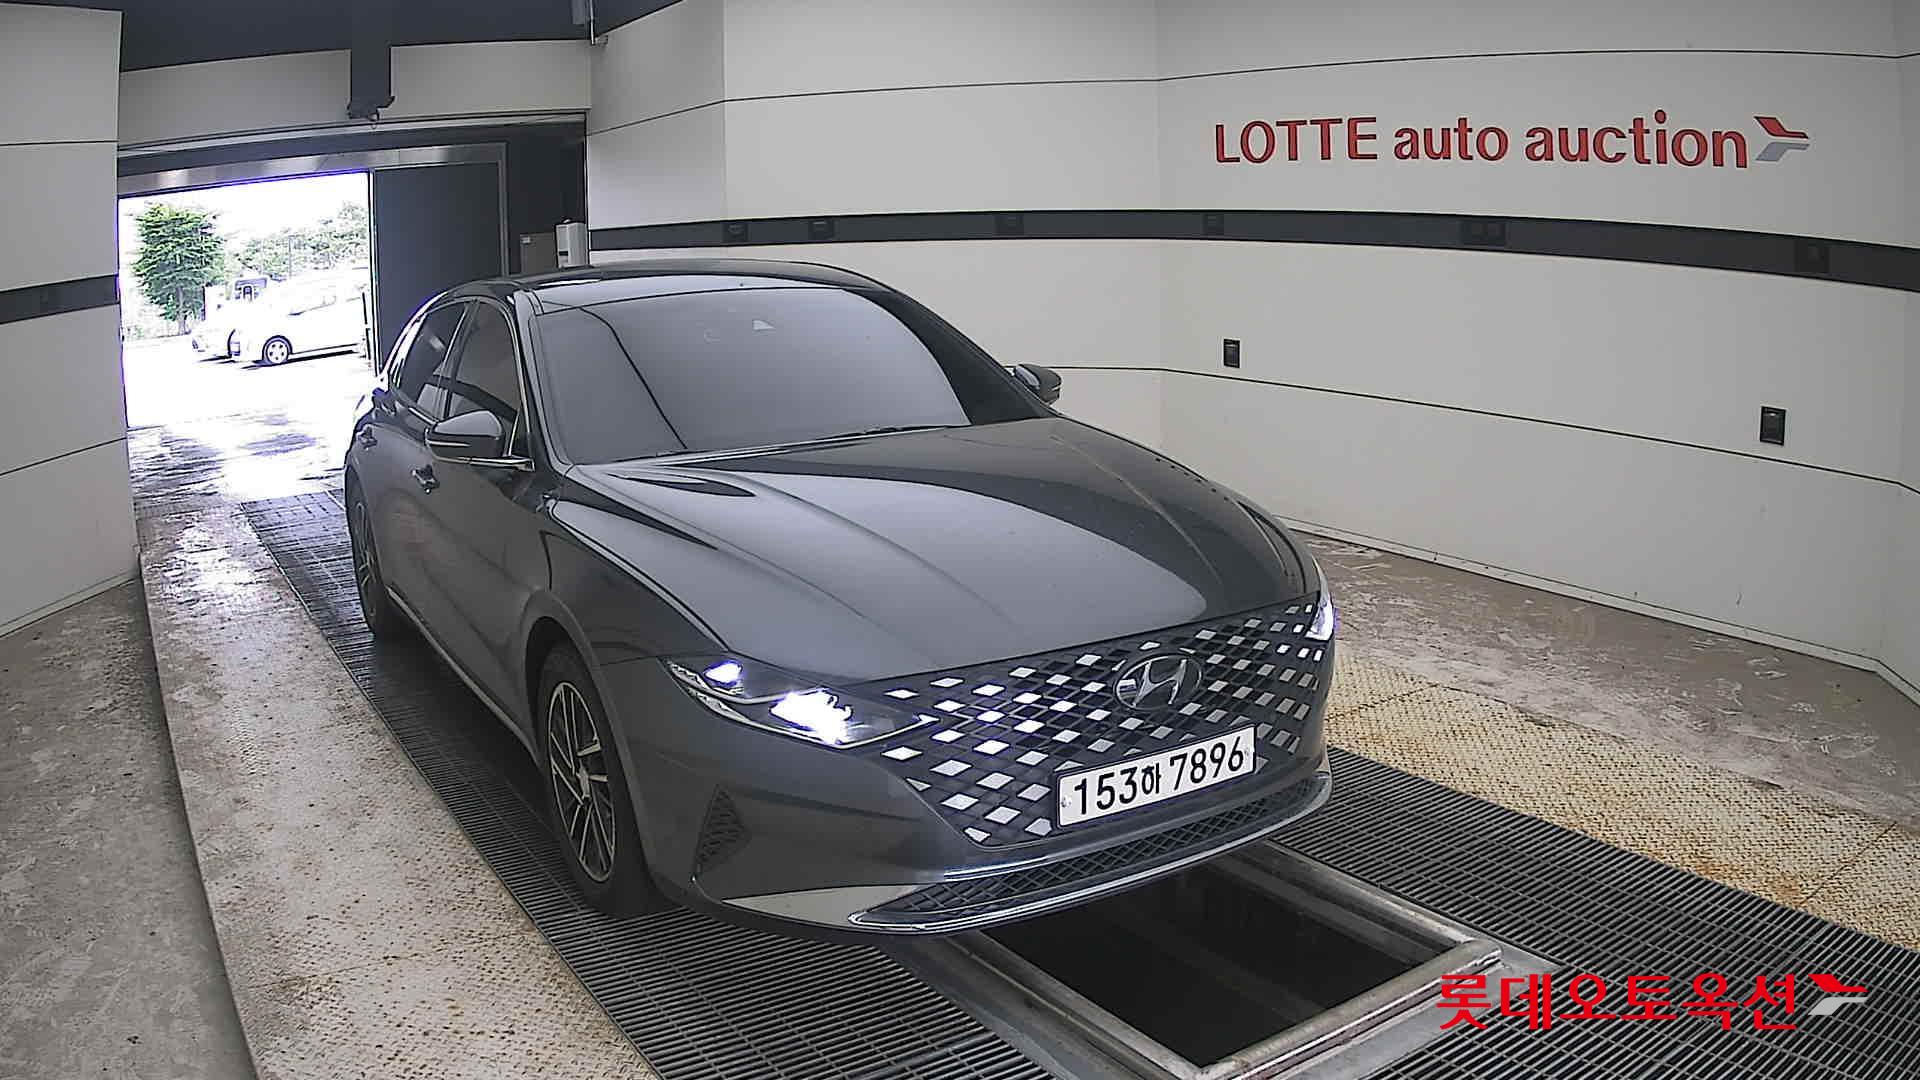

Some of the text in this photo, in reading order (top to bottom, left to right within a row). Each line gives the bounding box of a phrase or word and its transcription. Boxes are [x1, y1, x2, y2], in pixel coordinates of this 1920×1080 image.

[1215, 109, 1748, 168] LOTTE auto auction
[1074, 736, 1244, 815] 153하 7896
